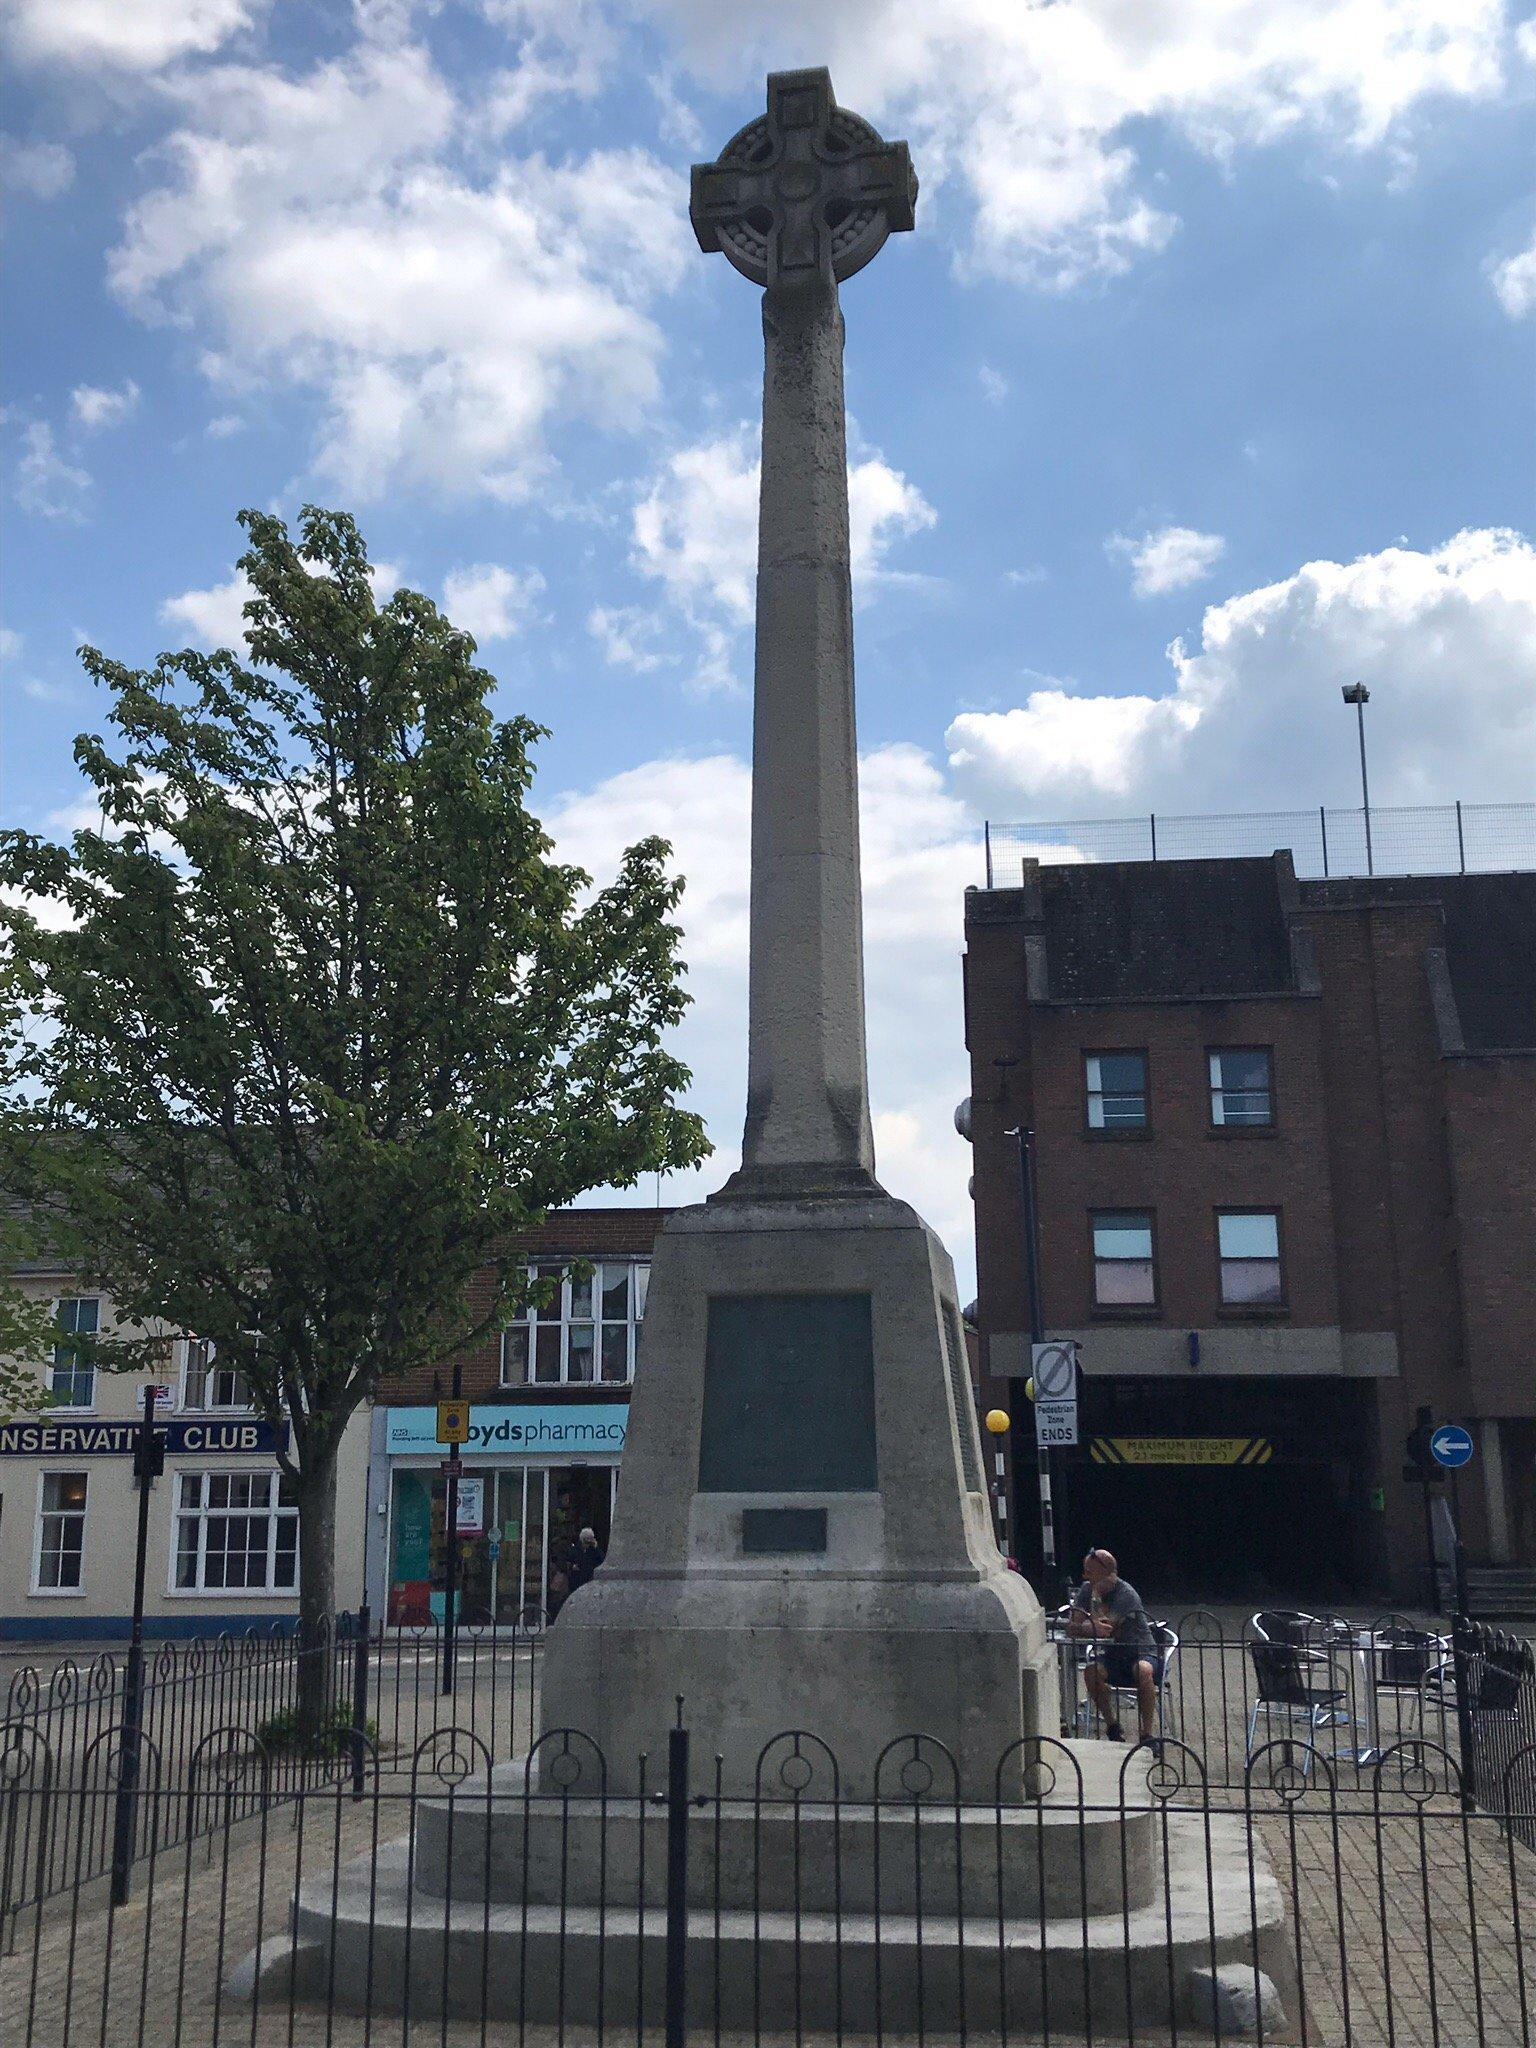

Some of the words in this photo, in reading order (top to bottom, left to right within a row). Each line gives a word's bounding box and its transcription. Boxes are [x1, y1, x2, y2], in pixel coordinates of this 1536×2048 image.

[1037, 1405, 1074, 1414] Pedestrian
[1047, 1415, 1064, 1424] Zone
[1, 1428, 168, 1451] NSERVATI
[184, 1427, 258, 1450] CLUB
[1042, 1428, 1073, 1441] ENDS
[1127, 1441, 1185, 1450] MAXIMUM
[1190, 1441, 1234, 1450] HEIGHT
